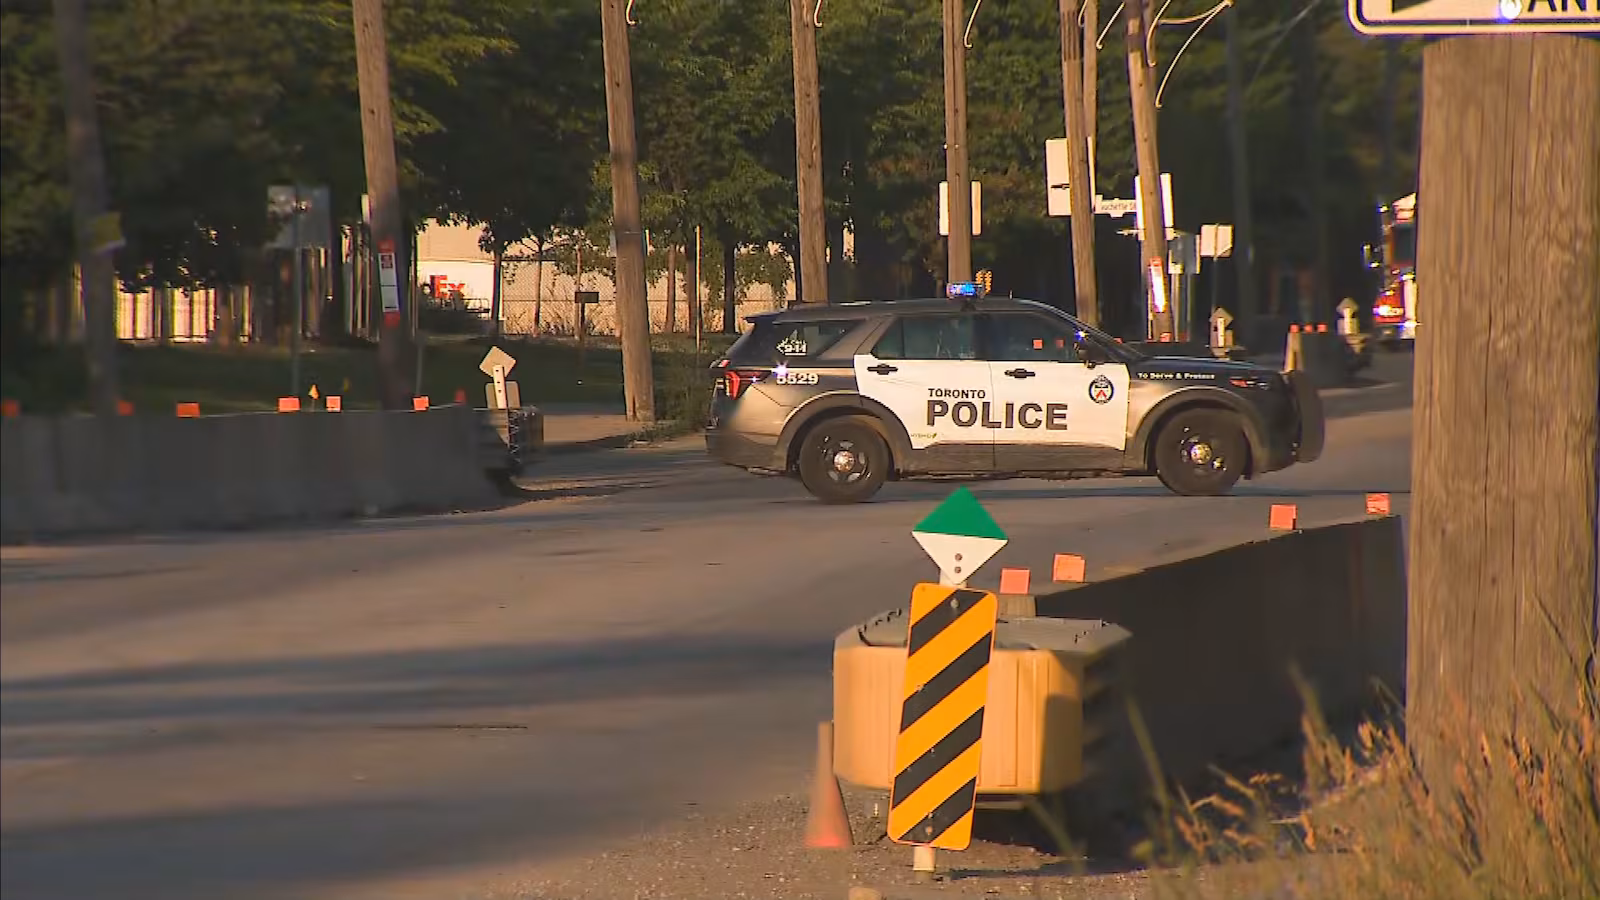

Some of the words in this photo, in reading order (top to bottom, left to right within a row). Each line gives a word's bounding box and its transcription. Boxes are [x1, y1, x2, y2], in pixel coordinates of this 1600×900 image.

[776, 372, 819, 385] 5529
[1175, 372, 1182, 380] &
[928, 388, 986, 399] TORONTO
[927, 400, 1068, 431] POLICE
